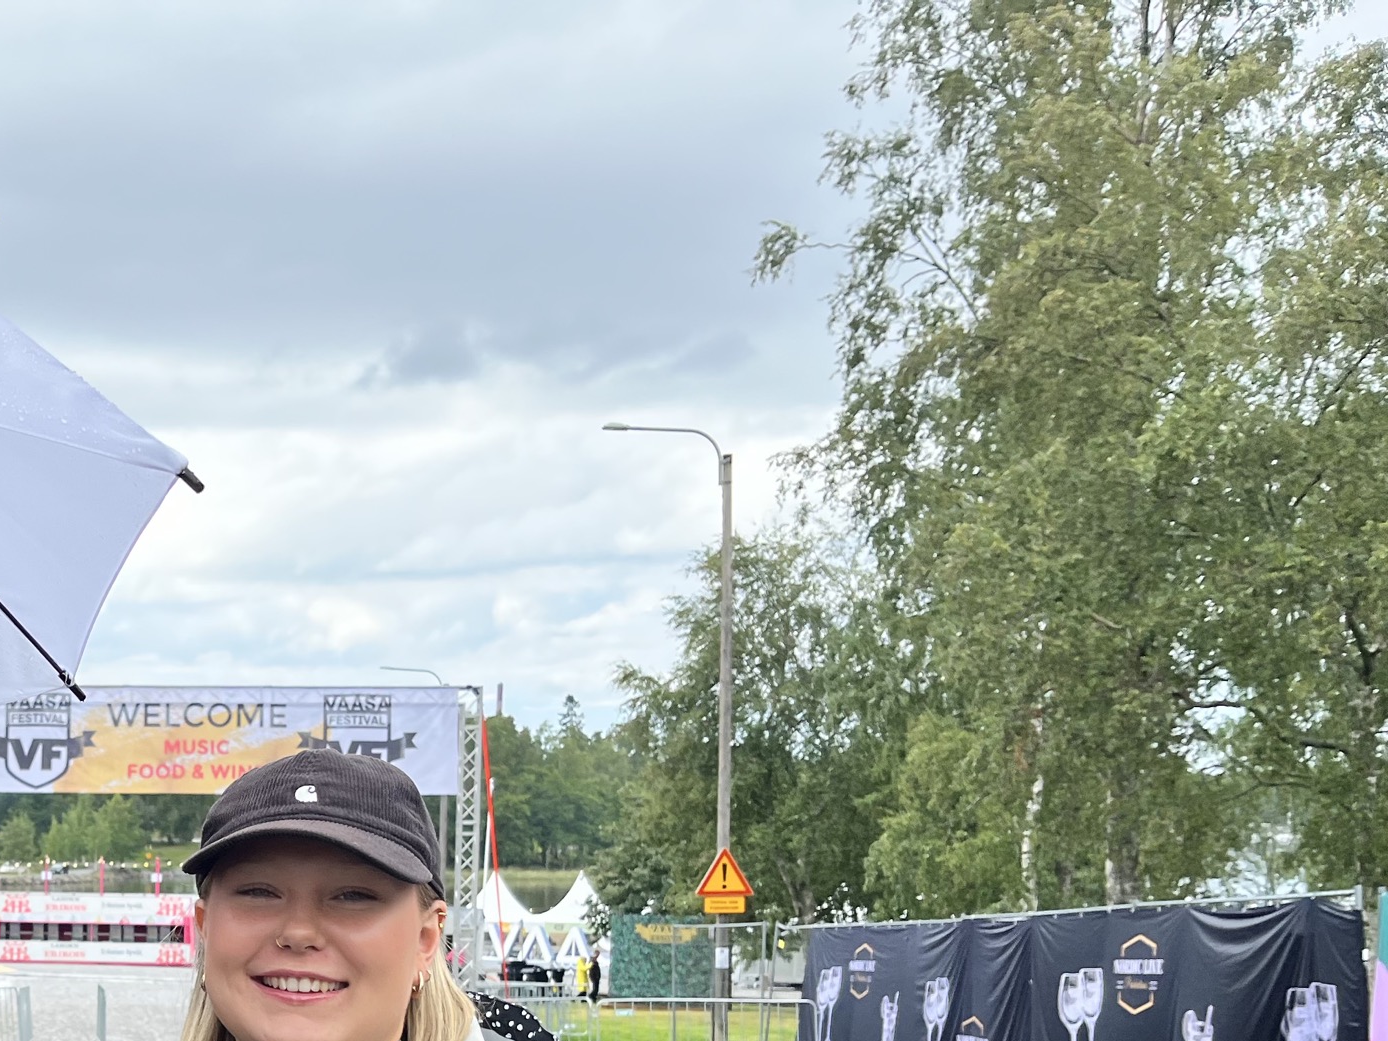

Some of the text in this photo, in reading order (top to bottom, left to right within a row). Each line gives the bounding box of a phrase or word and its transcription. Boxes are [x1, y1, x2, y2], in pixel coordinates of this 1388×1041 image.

[11, 713, 65, 724] FESTIVAL
[108, 703, 287, 728] WELCOME
[328, 714, 386, 726] FESTIVAL
[8, 738, 63, 771] VF
[163, 739, 230, 756] MUSIC
[127, 763, 262, 780] FOOD & WIN
